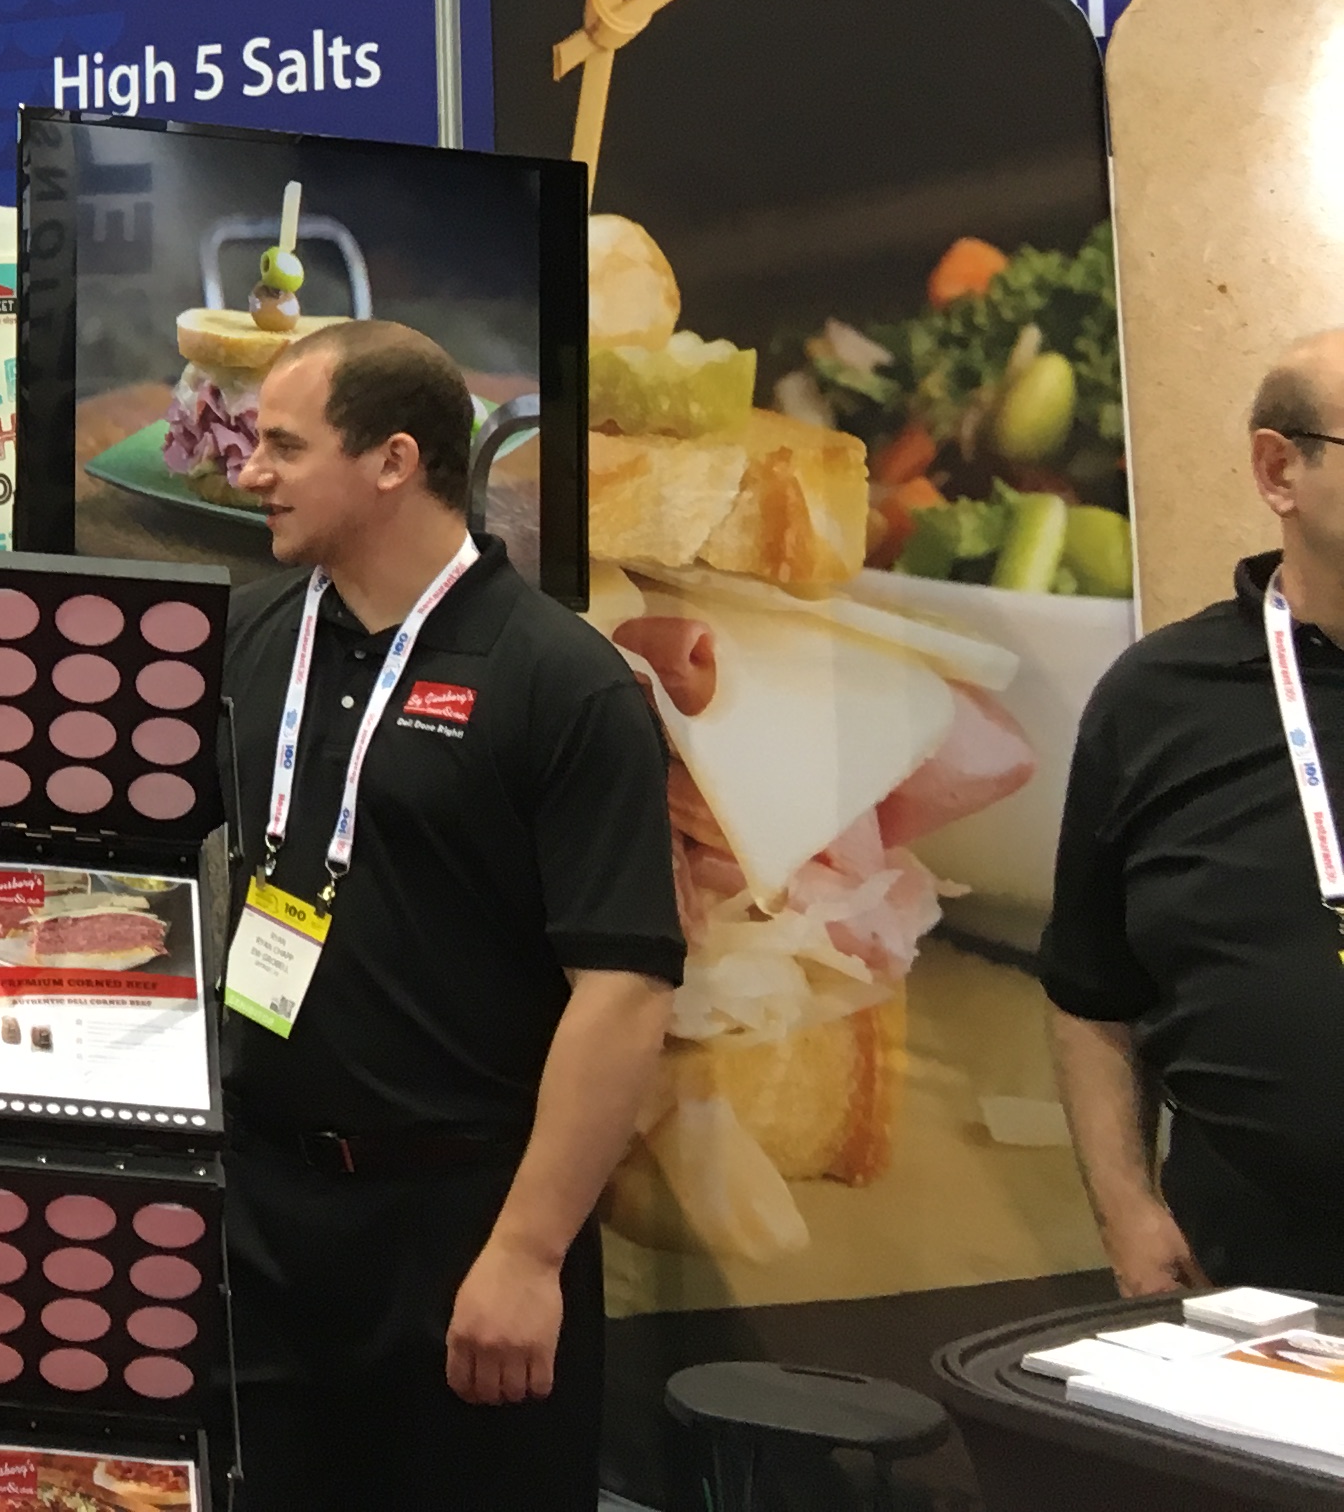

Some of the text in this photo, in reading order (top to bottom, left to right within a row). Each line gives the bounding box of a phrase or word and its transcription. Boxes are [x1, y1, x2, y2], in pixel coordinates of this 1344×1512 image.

[53, 28, 381, 118] High 5 Salts
[283, 901, 307, 923] 100
[67, 978, 122, 989] CORNED
